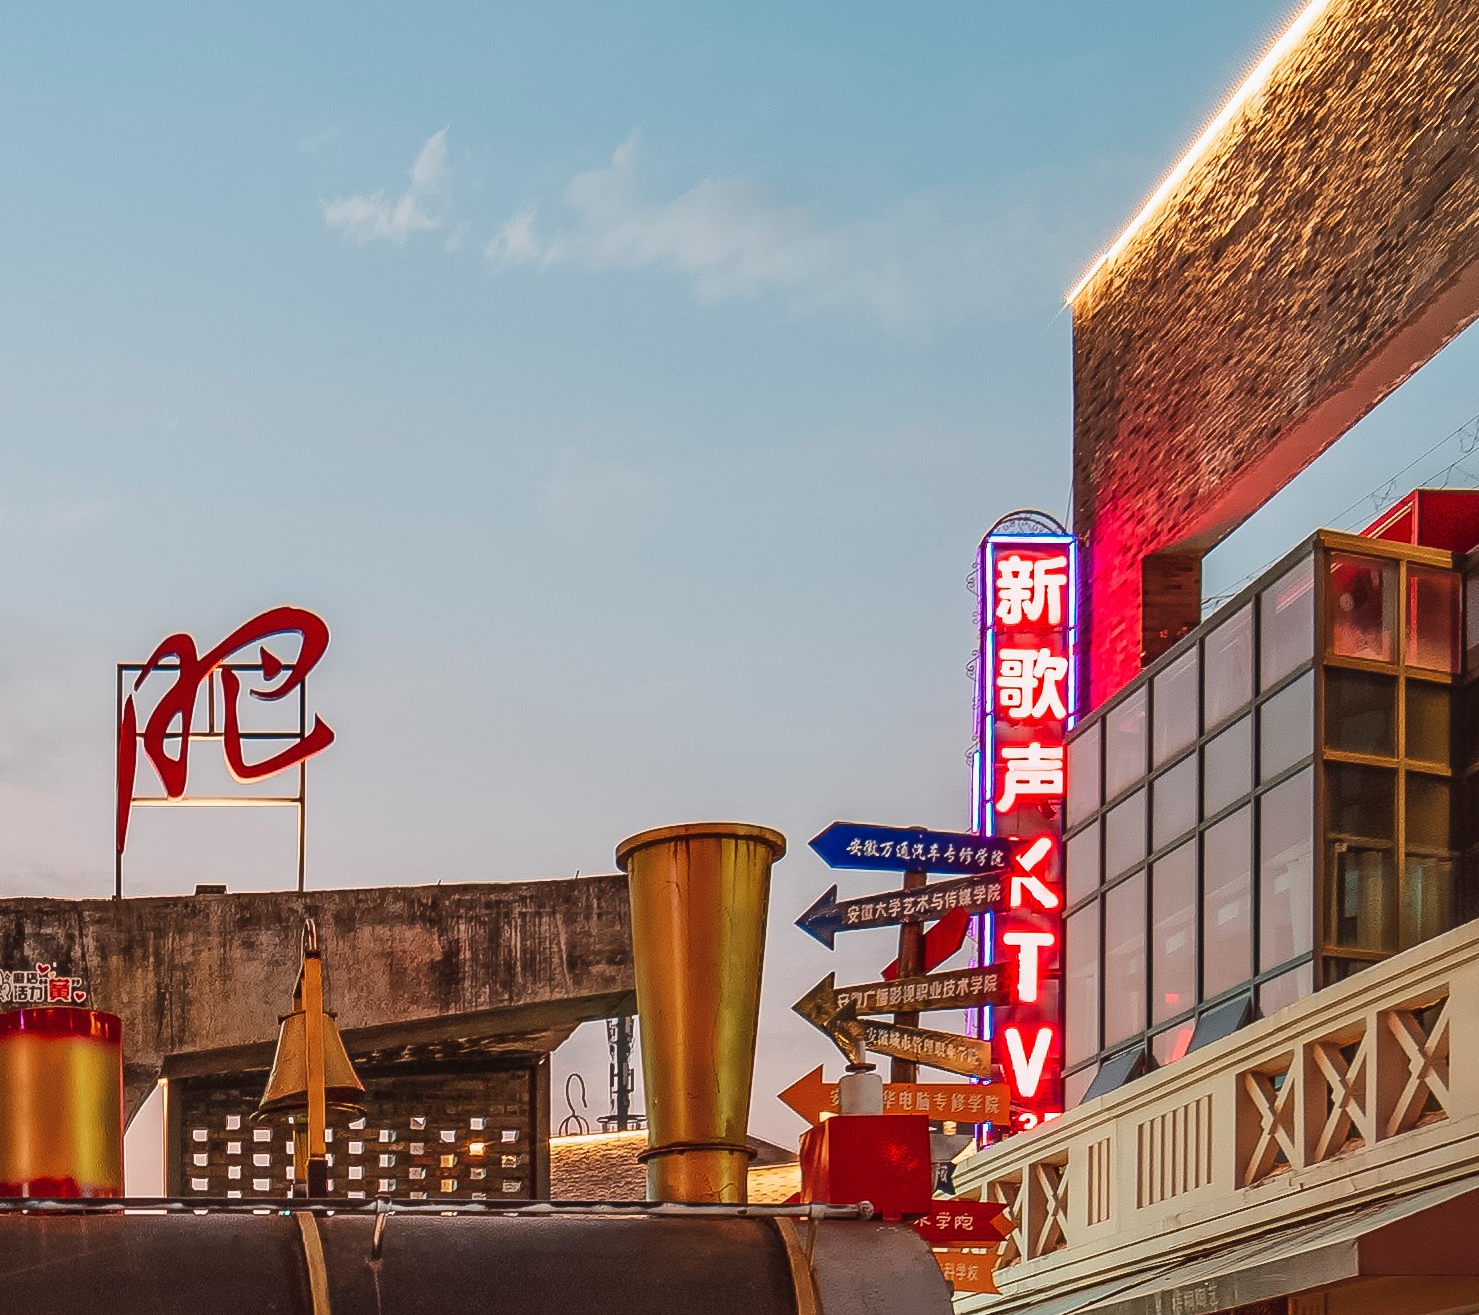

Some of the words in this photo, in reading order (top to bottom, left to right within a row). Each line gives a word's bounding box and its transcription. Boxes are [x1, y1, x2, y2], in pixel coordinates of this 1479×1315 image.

[996, 555, 1067, 1099] 新歌声KTV
[846, 838, 1005, 868] 安徽万通汽车专修学院
[847, 883, 1002, 924] 安徽大学艺术与传媒学院
[830, 1089, 1001, 1115] 安华电脑专修学院
